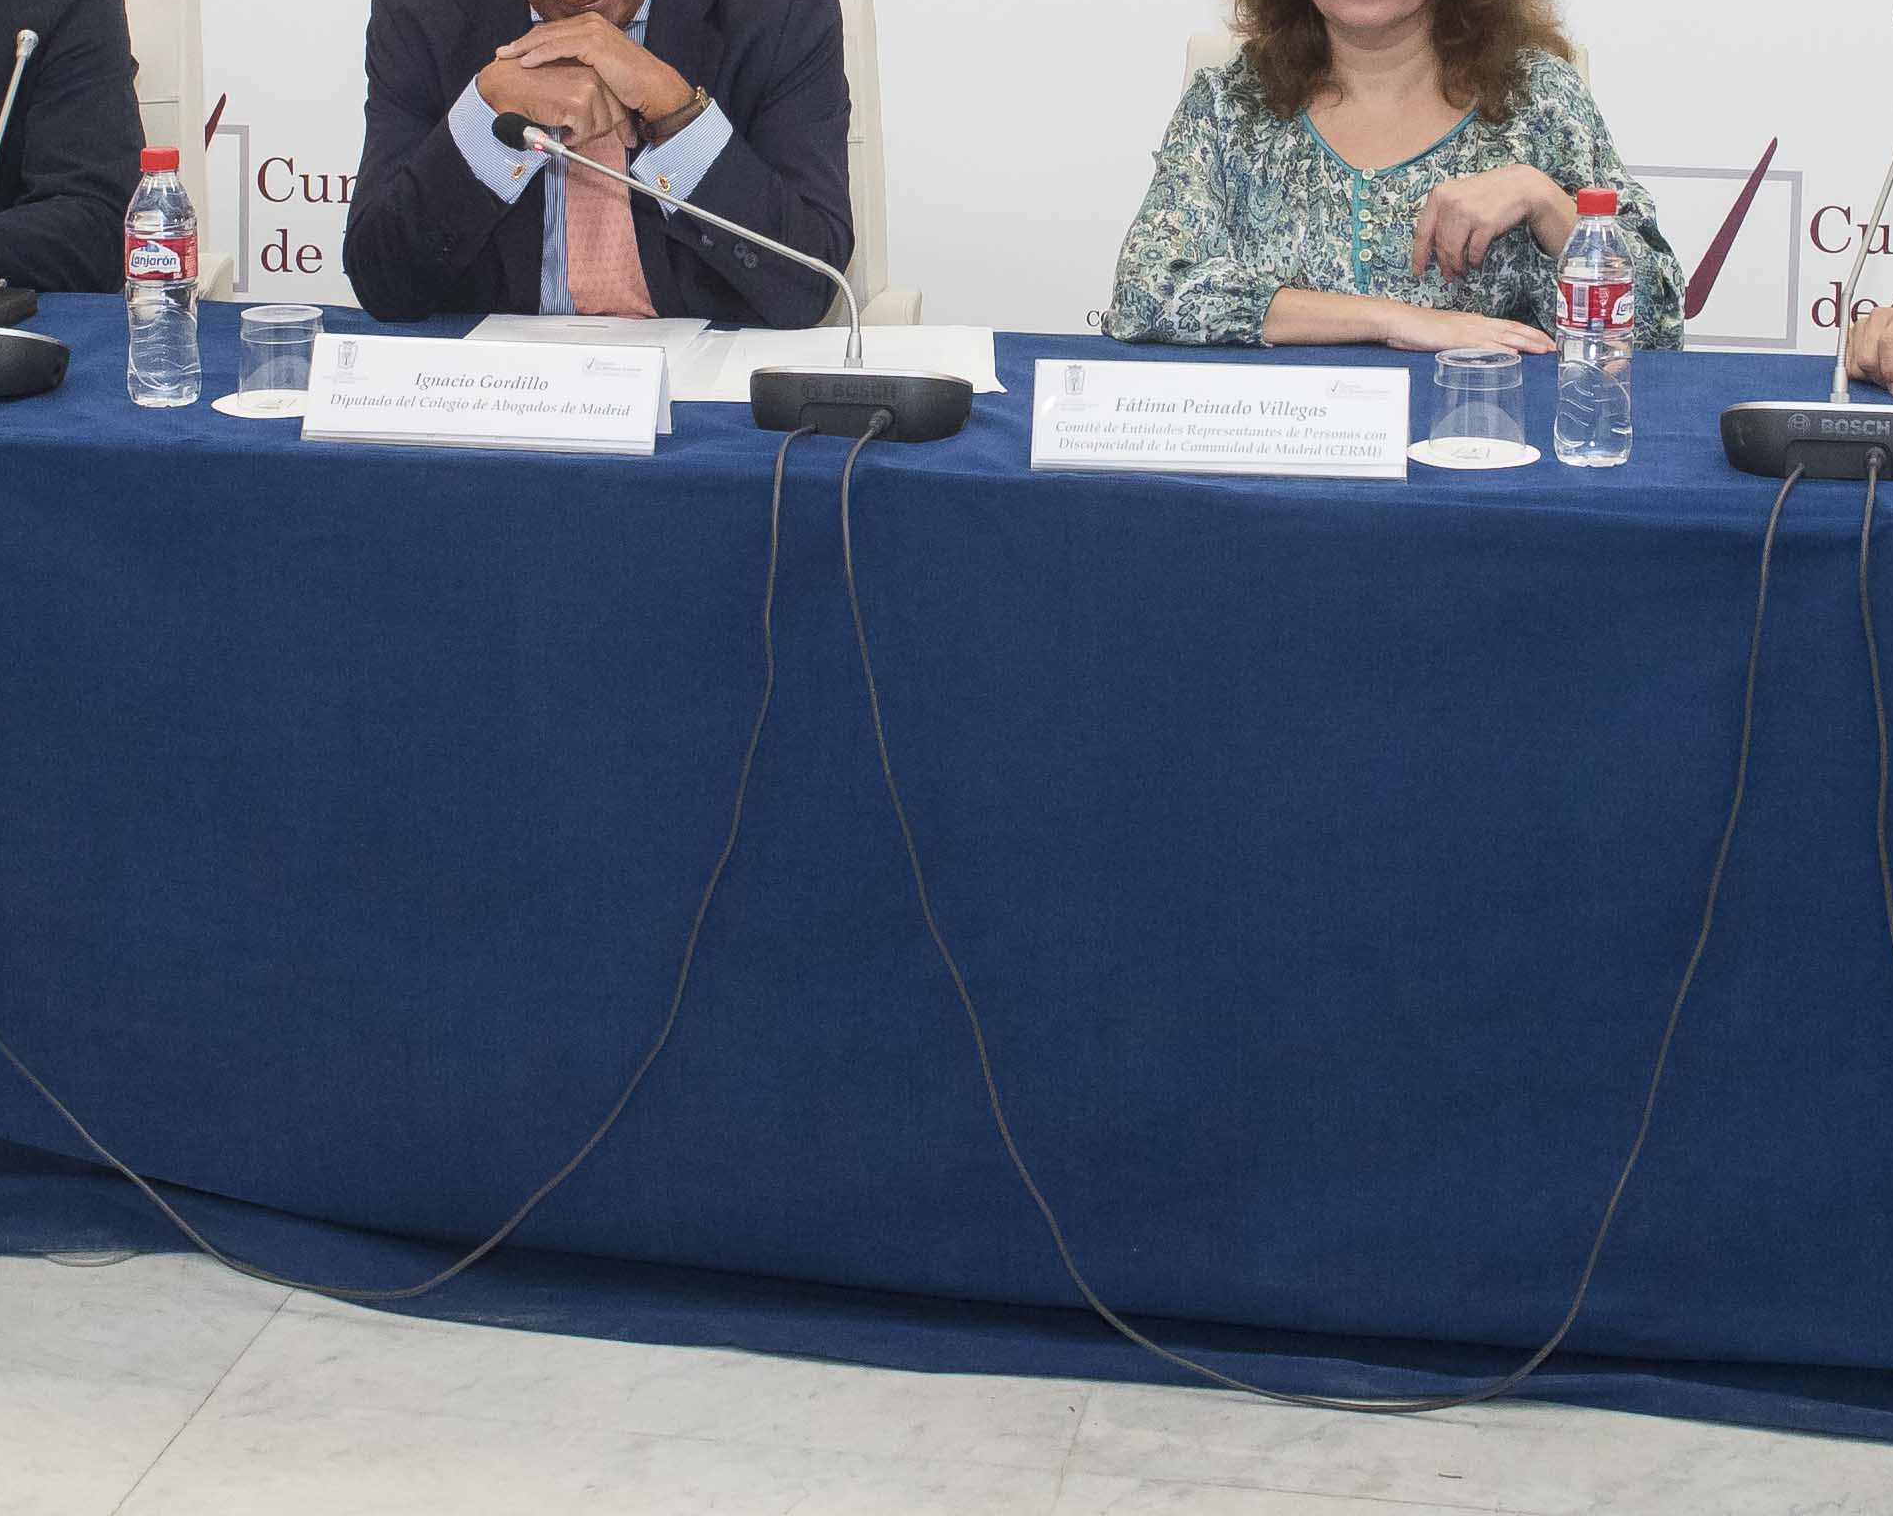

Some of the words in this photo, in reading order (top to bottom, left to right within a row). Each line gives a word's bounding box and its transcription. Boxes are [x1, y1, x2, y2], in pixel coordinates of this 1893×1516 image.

[261, 229, 322, 273] de
[131, 253, 177, 268] Lanjarón
[415, 373, 474, 391] Ignacio
[480, 375, 548, 390] Gordillo
[330, 394, 392, 408] Diputado
[395, 396, 415, 408] del
[419, 397, 469, 413] Colegio
[473, 398, 489, 411] de
[491, 399, 557, 415] Abogados
[561, 402, 577, 413] de
[579, 403, 630, 416] Madrid
[1116, 397, 1176, 412] Fátima
[1183, 399, 1251, 414] Peinado
[1260, 401, 1326, 421] Villegas
[1055, 421, 1102, 433] Comité
[1821, 420, 1891, 436] BOSCH
[1059, 438, 1145, 453] Discapacidad
[1180, 441, 1254, 455] Comunidad
[1274, 443, 1322, 457] Madrid
